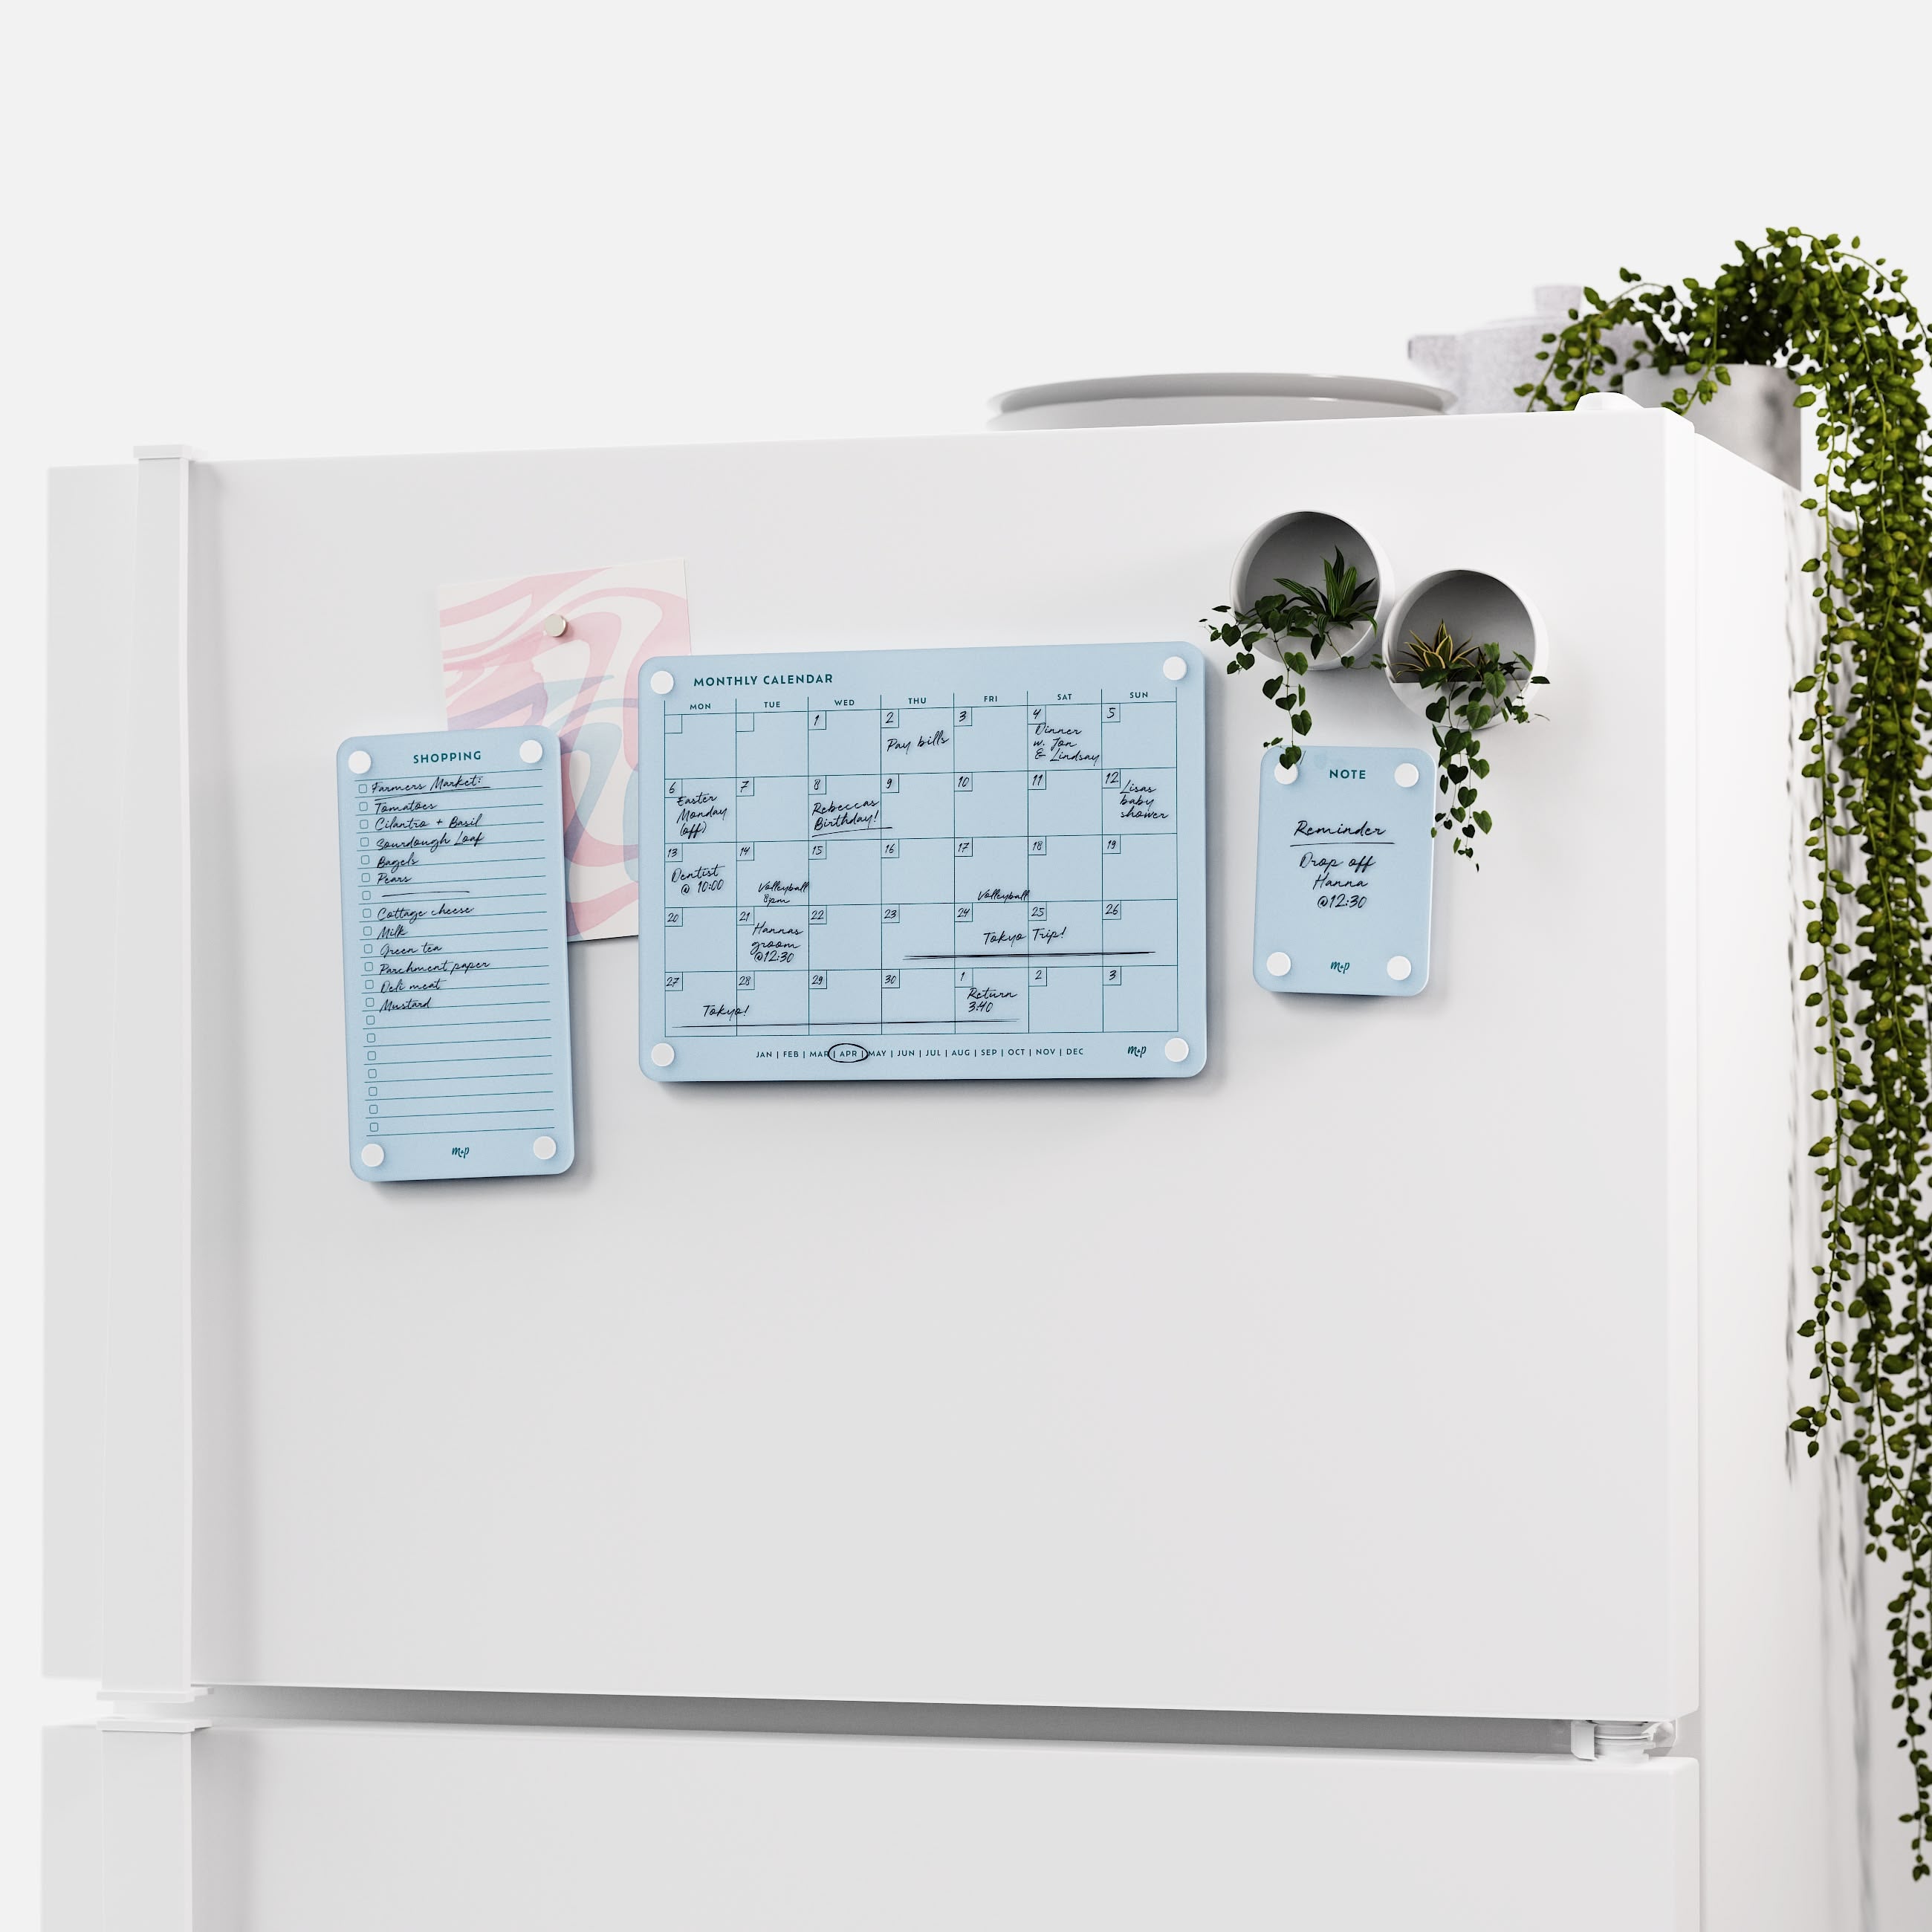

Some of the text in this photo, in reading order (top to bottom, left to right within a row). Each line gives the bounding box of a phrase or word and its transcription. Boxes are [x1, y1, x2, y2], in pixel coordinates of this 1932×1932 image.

[694, 674, 833, 687] MONTHLY CALENDAR
[886, 713, 894, 724] 2
[959, 711, 967, 722] 3
[1033, 709, 1041, 719] 4
[1107, 707, 1115, 718] 5
[814, 715, 819, 726] 1
[1035, 722, 1082, 736] Dinner
[887, 730, 950, 754] Pay bills
[1051, 737, 1077, 751] Jon
[413, 751, 482, 763] SHOPPING
[1035, 748, 1100, 766] & Lindsay
[1032, 775, 1043, 786] 11
[1106, 772, 1119, 784] 12
[1329, 770, 1366, 779] NOTE
[372, 782, 427, 794] Farmers
[670, 782, 675, 794] 6
[740, 781, 748, 792] 7
[814, 779, 820, 791] 8
[886, 779, 892, 788] 9
[958, 777, 970, 787] 10
[1121, 779, 1157, 794] Lisas
[677, 793, 718, 807] Easter
[1120, 794, 1154, 808] baby
[375, 802, 437, 814] Tomatoes
[812, 798, 879, 816] Rebeccas
[677, 806, 727, 823] Monday
[1121, 808, 1169, 819] shower
[375, 818, 429, 830] Cilantro
[448, 814, 482, 829] Basil
[814, 811, 878, 832] Birthday!
[680, 822, 707, 839] (off)
[1294, 820, 1387, 837] Reminder
[377, 832, 484, 852] Sourdough Loaf
[958, 842, 970, 852] 17
[1032, 841, 1042, 851] 18
[1107, 839, 1116, 849] 19
[667, 847, 678, 857] 13
[740, 846, 751, 856] 14
[812, 846, 823, 855] 15
[885, 844, 895, 854] 16
[377, 852, 418, 872] Bagels
[1300, 852, 1375, 873] Drop off
[377, 873, 412, 884] Pears
[672, 864, 725, 883] Dentist
[1313, 872, 1368, 889] Hanna
[681, 879, 724, 895] @ 10:00
[758, 882, 809, 893] Volleyball
[763, 894, 790, 907] 8pm
[978, 889, 1029, 902] Volleyball
[1317, 894, 1367, 908] @12:30
[377, 904, 474, 924] Cottage cheese
[811, 910, 824, 921] 22
[884, 909, 897, 920] 23
[957, 908, 970, 918] 24
[1031, 907, 1044, 917] 25
[1106, 904, 1119, 915] 26
[667, 912, 679, 923] 20
[739, 911, 751, 921] 21
[377, 925, 408, 940] Milk
[752, 922, 803, 936] Hannas
[983, 927, 1067, 947] Tokyo Trip!
[380, 940, 442, 956] Green tea
[750, 940, 800, 955] groom
[754, 950, 794, 963] @12:30
[379, 962, 490, 975] Parchment paper
[739, 976, 751, 985] 28
[812, 975, 823, 985] 29
[885, 974, 897, 985] 30
[960, 971, 965, 982] 1
[1035, 970, 1042, 980] 2
[1109, 970, 1116, 980] 3
[380, 979, 447, 993] Deli meat
[666, 977, 679, 987] 27
[967, 988, 1017, 999] Return
[379, 997, 431, 1013] Mustard
[968, 1002, 993, 1013] 3:40
[703, 1005, 750, 1020] Tokyo!
